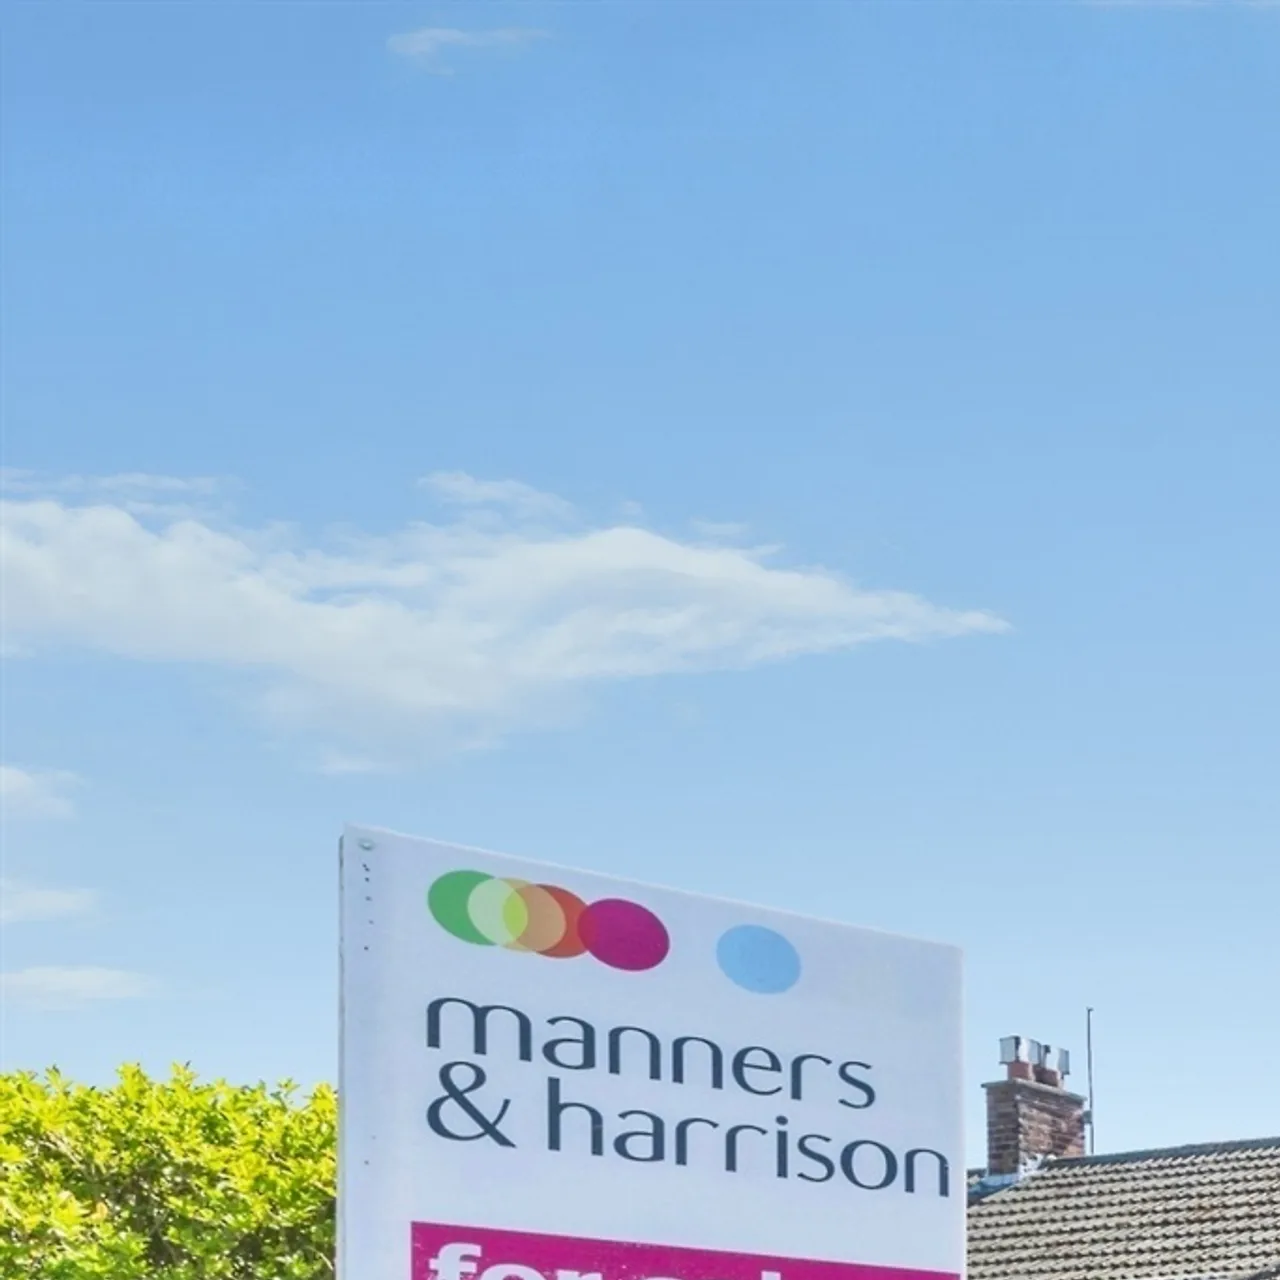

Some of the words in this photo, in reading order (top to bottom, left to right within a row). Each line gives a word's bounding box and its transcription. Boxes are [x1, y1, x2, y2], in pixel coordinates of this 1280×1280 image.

[426, 997, 876, 1110] manners
[426, 1061, 516, 1148] &
[547, 1076, 950, 1198] harrison
